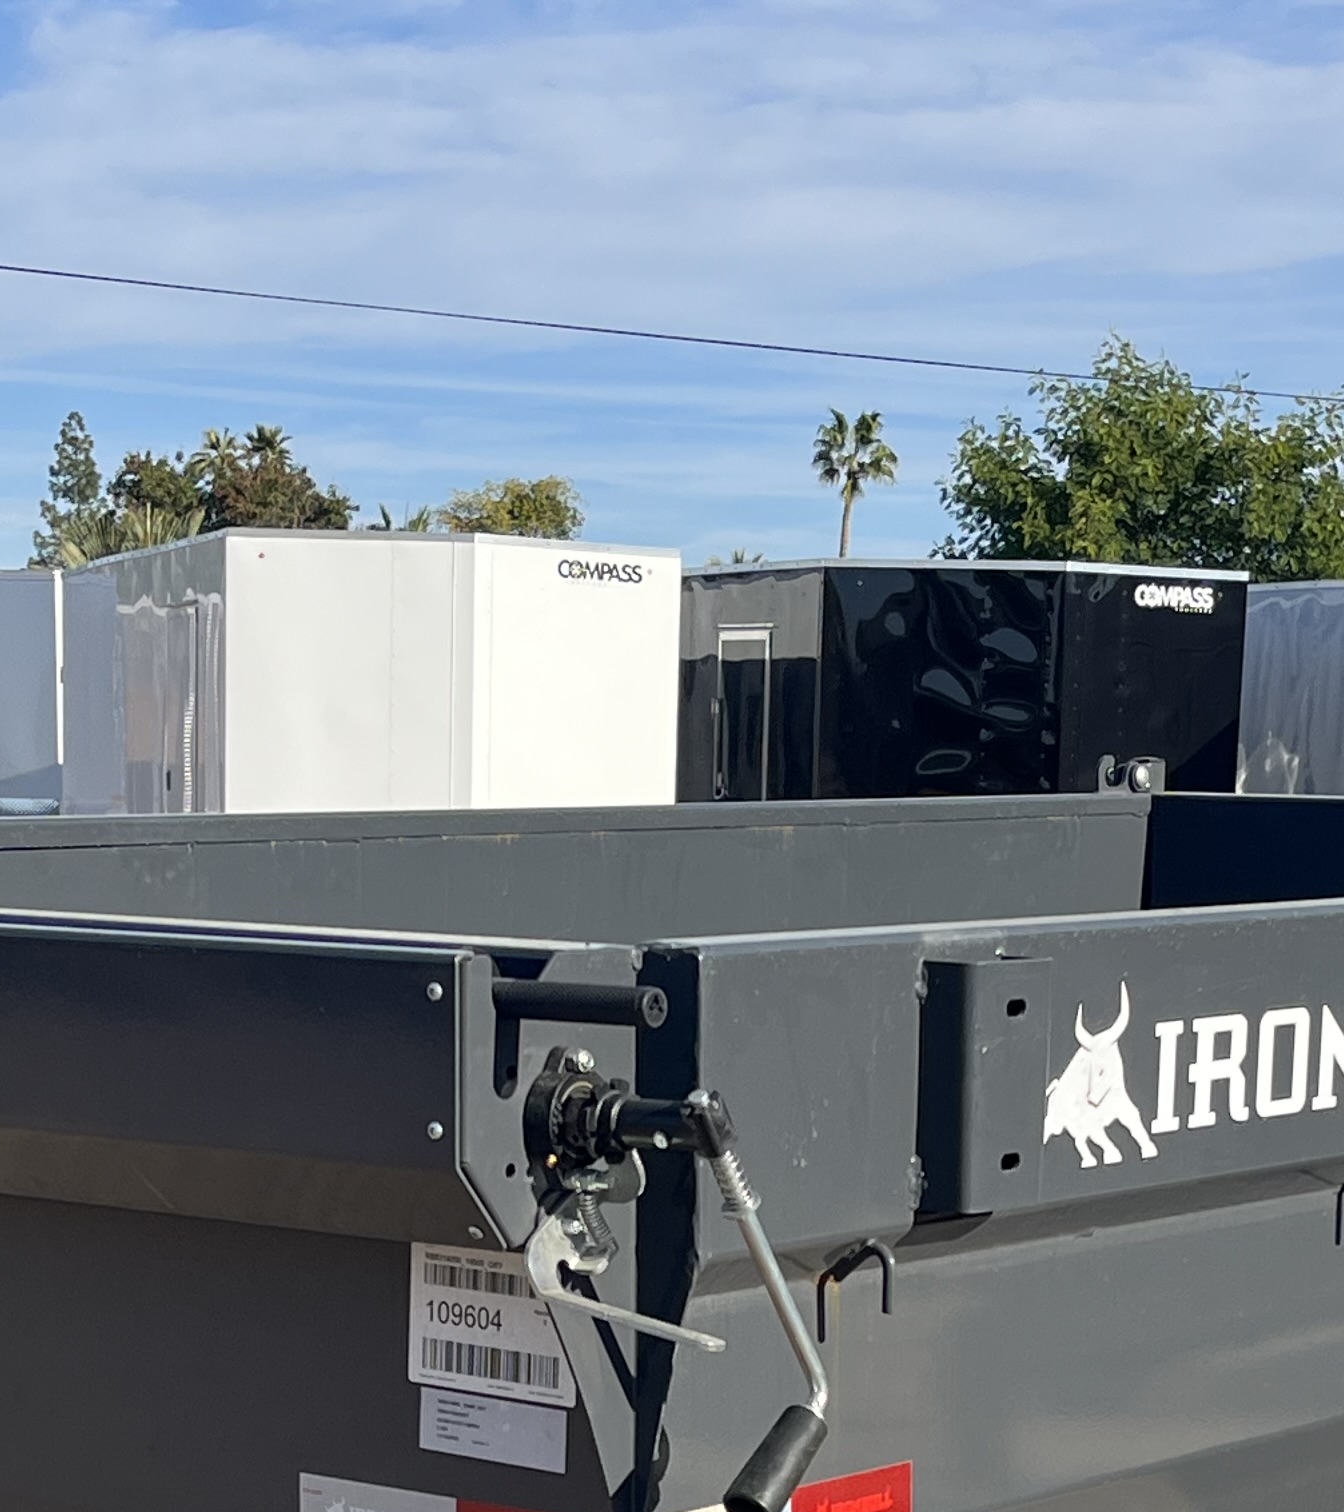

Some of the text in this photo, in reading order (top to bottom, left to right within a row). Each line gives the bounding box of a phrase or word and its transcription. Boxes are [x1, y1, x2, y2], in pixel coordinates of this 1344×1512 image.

[558, 559, 643, 583] COMPASS
[1134, 583, 1214, 608] COMPASS
[425, 1300, 503, 1332] 109604
